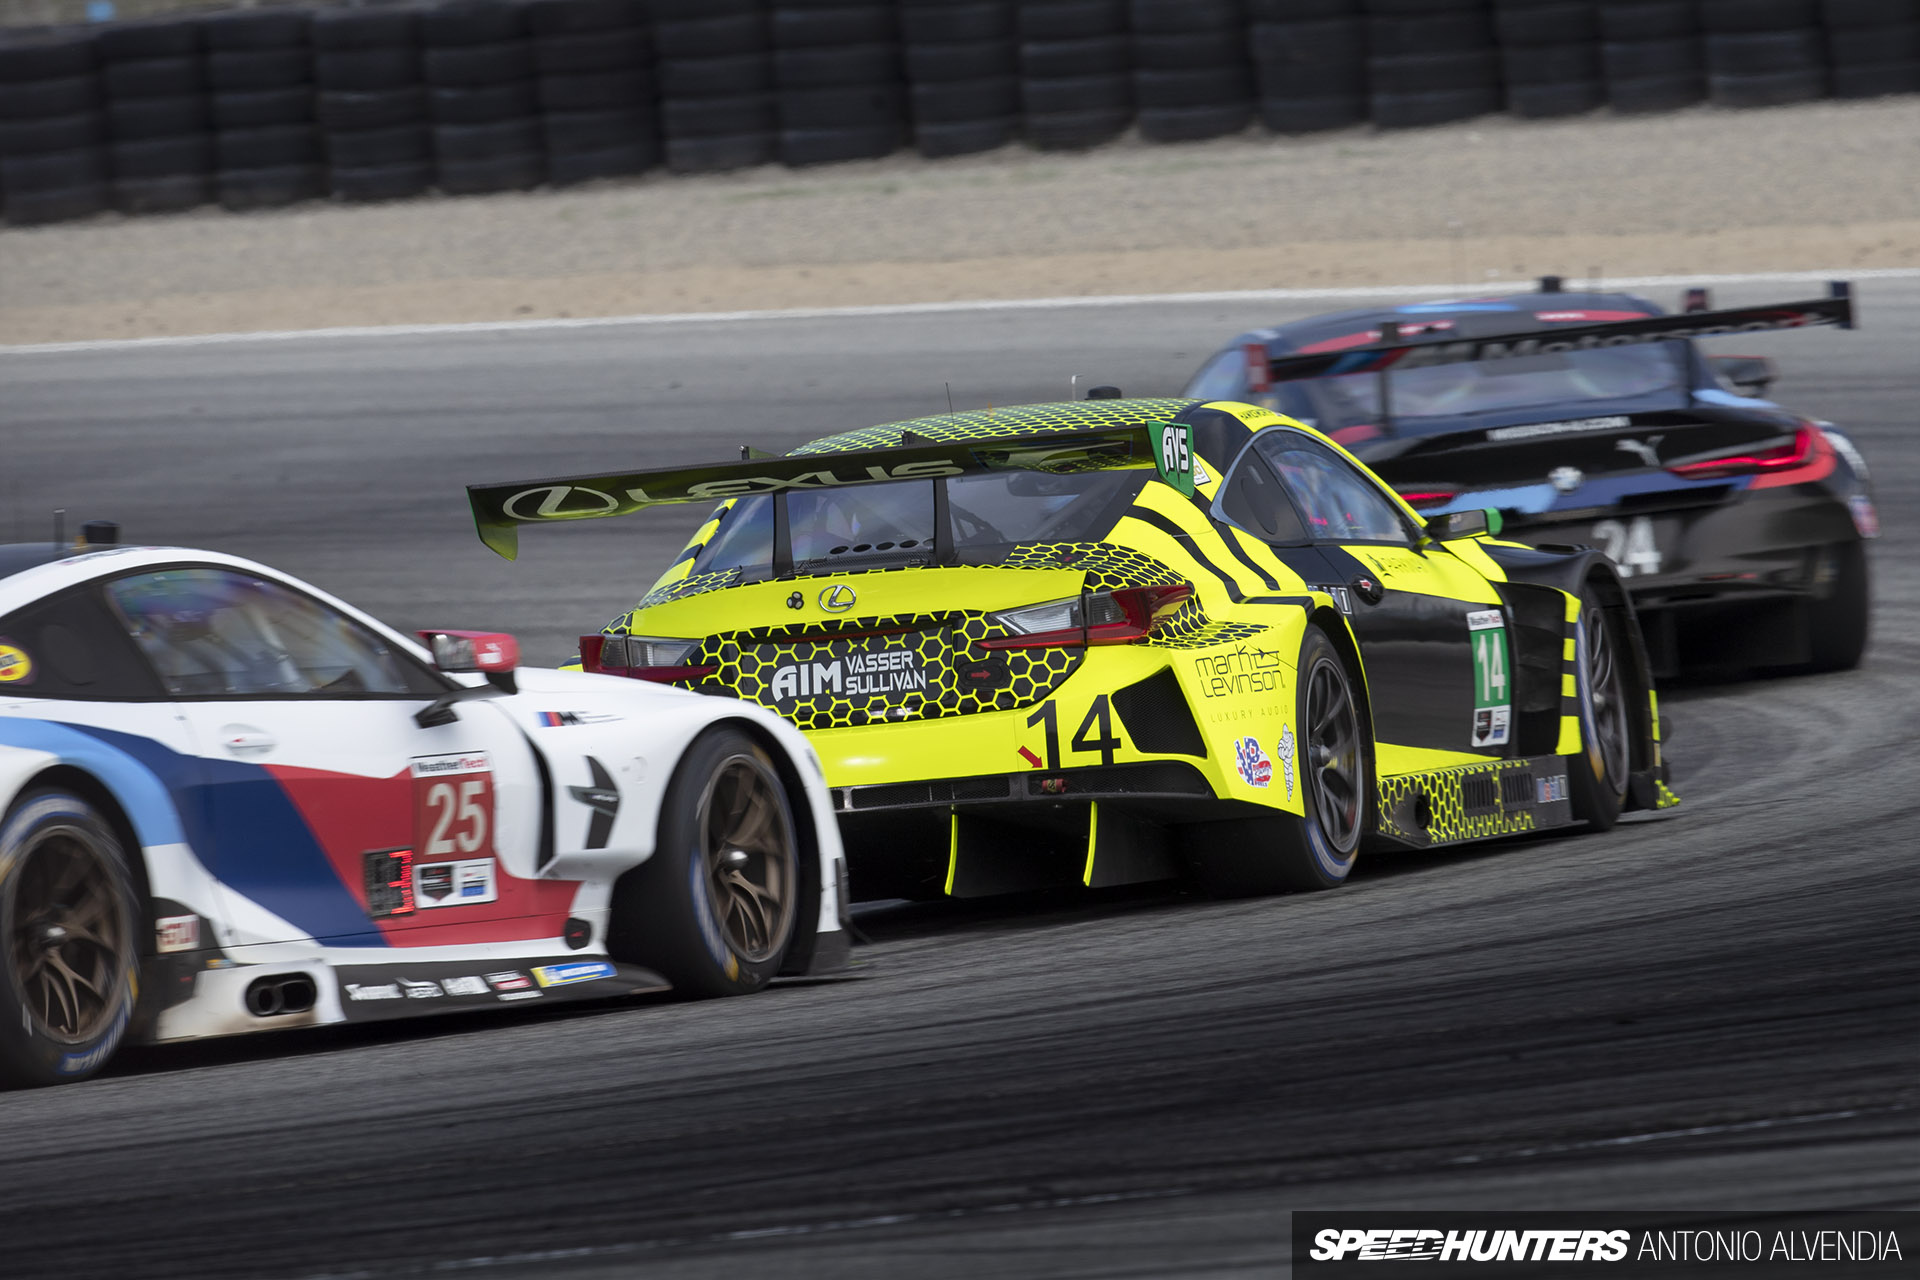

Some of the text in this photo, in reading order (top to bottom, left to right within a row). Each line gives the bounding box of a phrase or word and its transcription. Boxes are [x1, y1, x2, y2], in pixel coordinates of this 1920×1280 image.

[1162, 425, 1190, 482] AVS
[625, 459, 965, 504] LEXUS
[1591, 515, 1663, 578] 24
[771, 660, 843, 702] AIM
[845, 650, 914, 675] VASSER
[845, 670, 927, 695] SULLIVAN
[1194, 643, 1254, 678] mark
[1477, 631, 1506, 702] 14
[1026, 693, 1122, 770] 14
[1210, 703, 1290, 724] LUXURY AUDIO
[424, 779, 488, 856] 25
